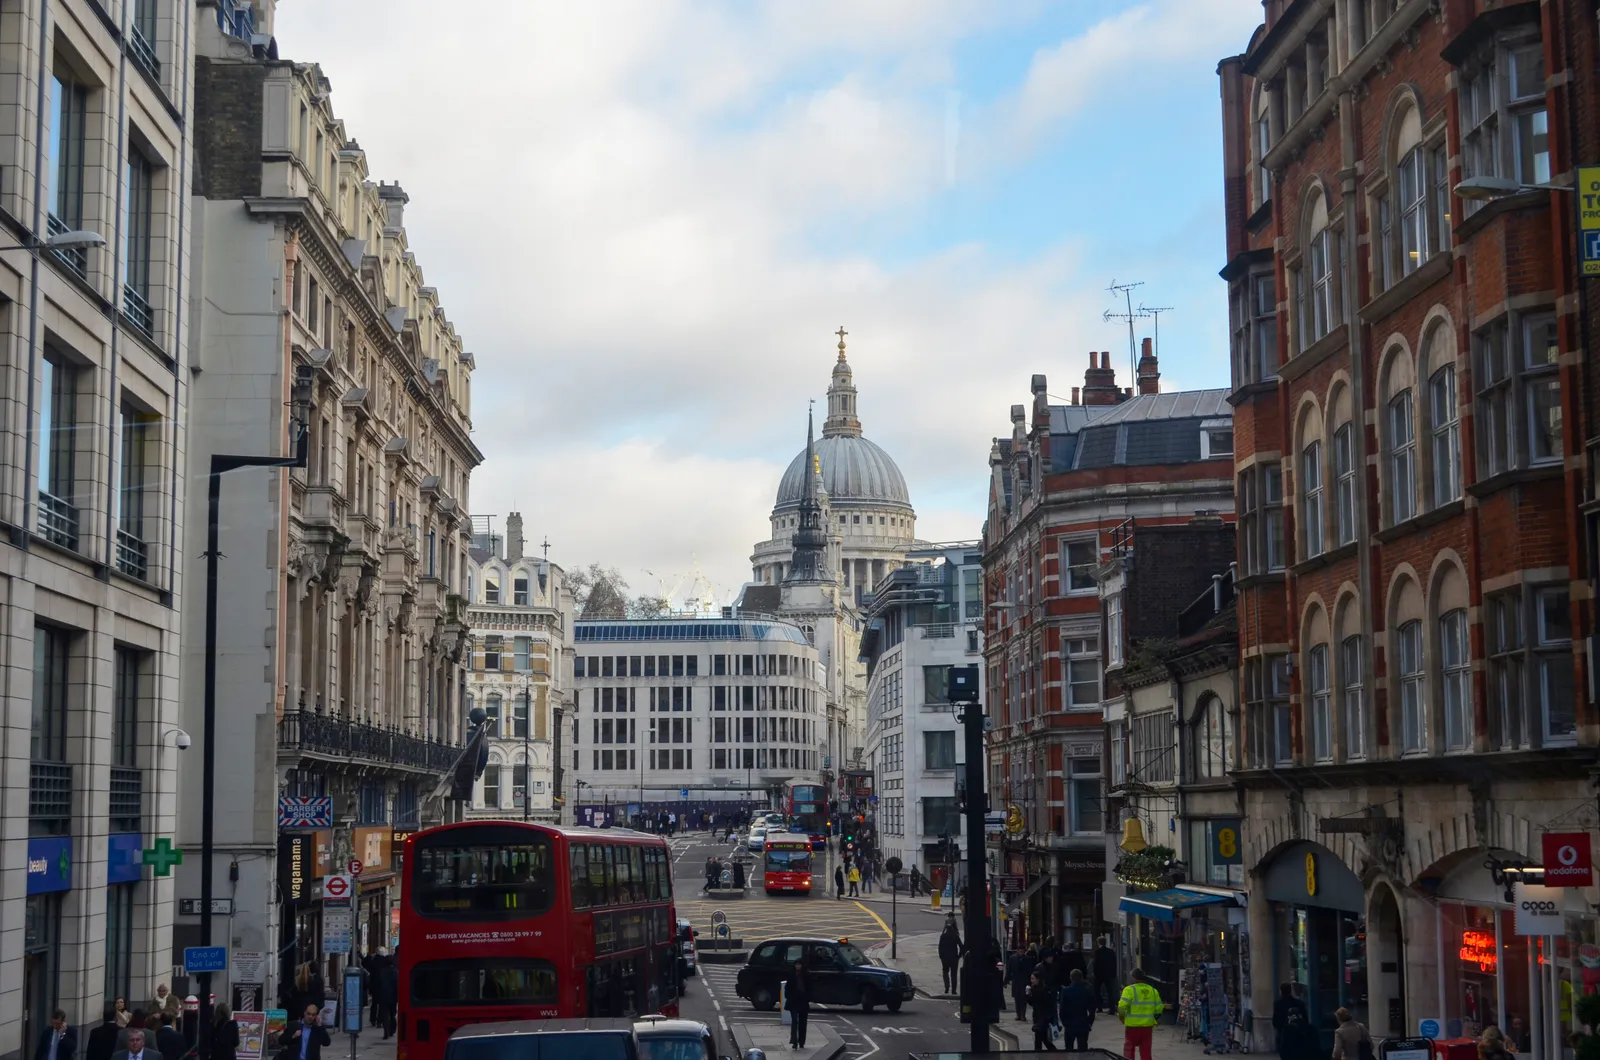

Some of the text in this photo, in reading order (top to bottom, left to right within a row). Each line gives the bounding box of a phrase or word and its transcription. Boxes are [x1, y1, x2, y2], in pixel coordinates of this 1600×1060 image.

[394, 832, 412, 841] EA
[28, 856, 48, 875] beauty
[291, 838, 303, 899] wagamama
[351, 862, 360, 873] E
[1086, 860, 1105, 868] Steven
[1548, 866, 1588, 875] vodafone
[505, 892, 518, 909] 11
[192, 950, 219, 959] End of
[188, 960, 204, 968] bus
